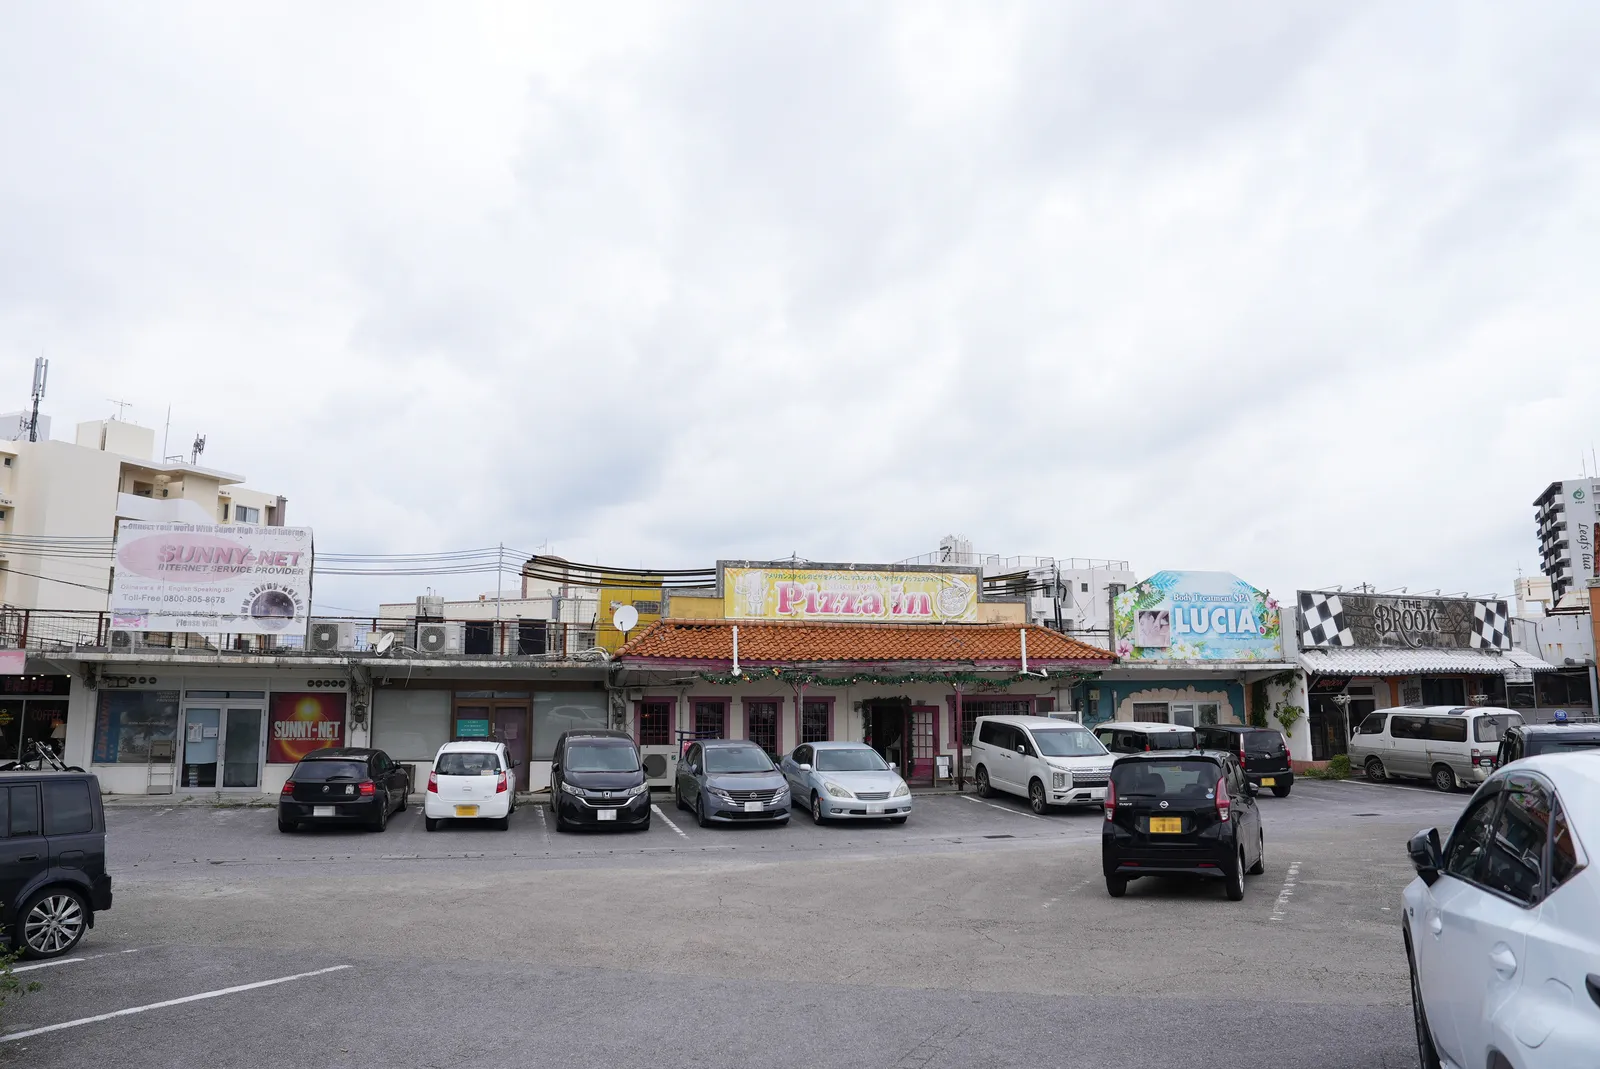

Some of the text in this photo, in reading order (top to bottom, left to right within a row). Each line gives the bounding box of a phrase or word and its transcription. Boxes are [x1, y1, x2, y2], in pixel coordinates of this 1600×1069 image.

[1576, 522, 1592, 550] Leafs
[157, 545, 304, 567] SUNNY-NET
[210, 565, 252, 574] SERVICE
[254, 567, 304, 576] PROVIDER
[122, 593, 226, 604] Toll-Free 0800-805-8678
[776, 581, 883, 615] Pizza
[1173, 592, 1250, 603] Body Treatment SPA
[1401, 599, 1422, 610] THE
[1174, 607, 1257, 634] LUCIA
[1374, 603, 1440, 650] BROOK
[274, 720, 340, 738] SUNNY-NET
